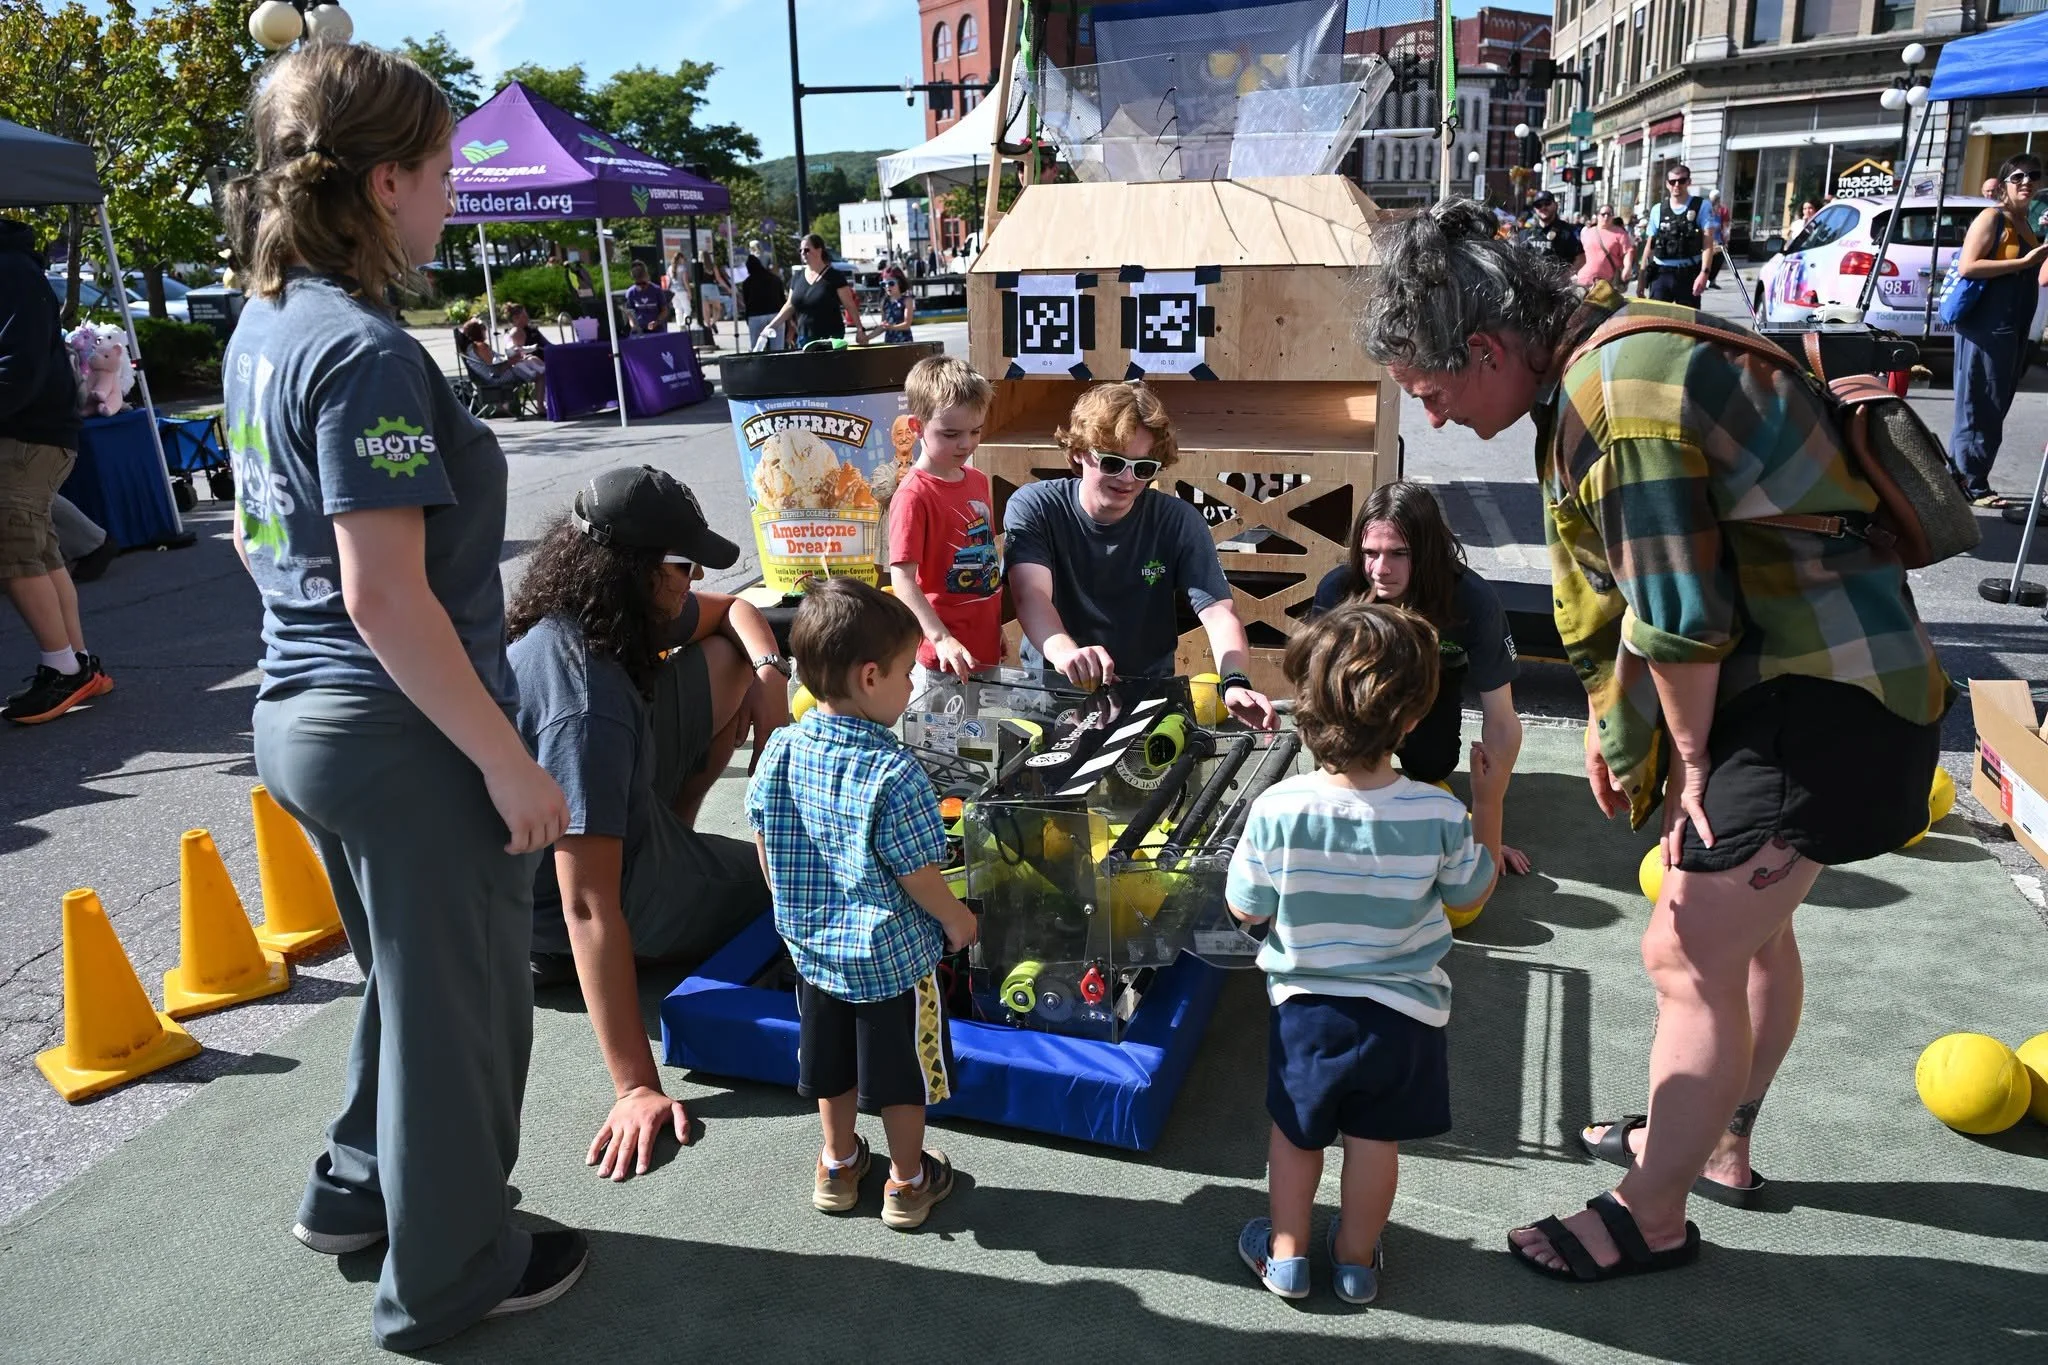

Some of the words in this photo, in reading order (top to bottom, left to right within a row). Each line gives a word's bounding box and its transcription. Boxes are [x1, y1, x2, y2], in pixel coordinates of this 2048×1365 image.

[472, 165, 547, 176] FEDERAL
[1838, 172, 1894, 188] masala
[648, 188, 679, 200] VERMONT
[679, 190, 704, 201] FEDERAL
[455, 192, 573, 214] tfederal.org
[1884, 280, 1914, 295] 98.1
[386, 453, 411, 462] 2370
[771, 522, 857, 539] Americone
[786, 540, 843, 554] Dream
